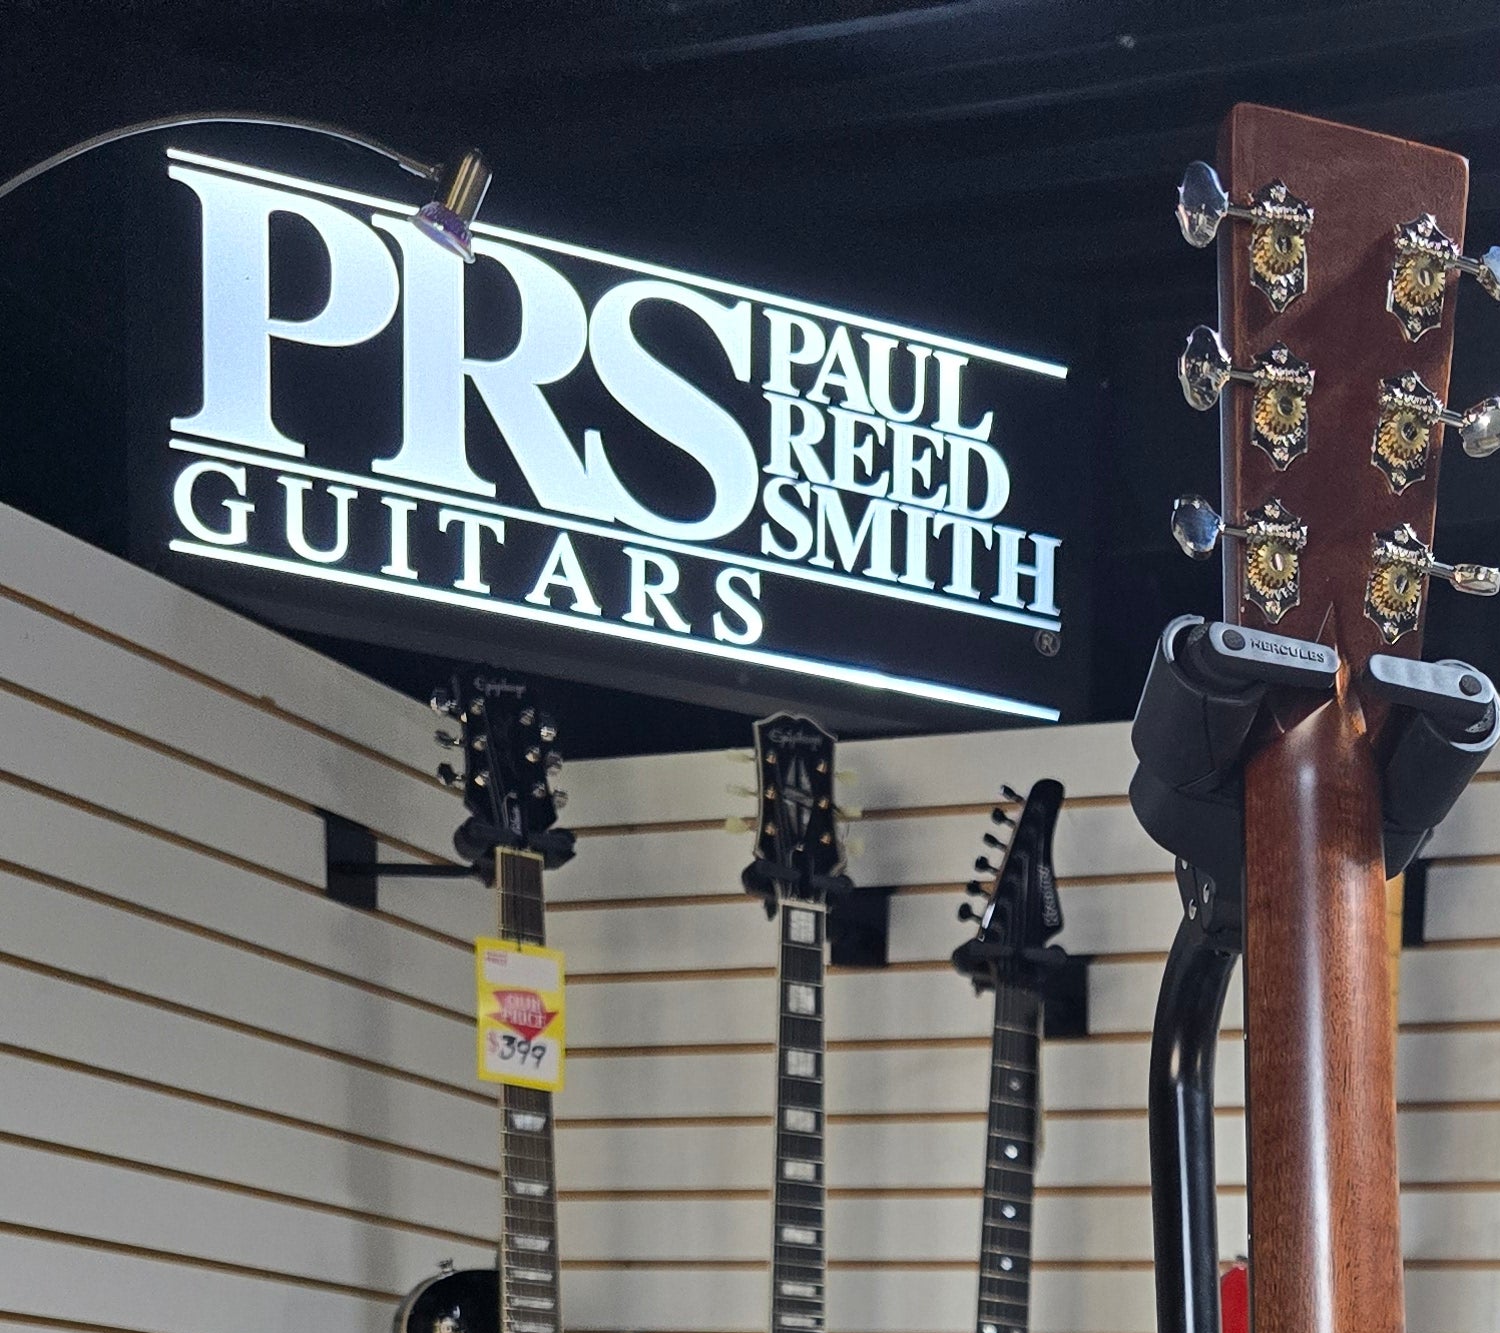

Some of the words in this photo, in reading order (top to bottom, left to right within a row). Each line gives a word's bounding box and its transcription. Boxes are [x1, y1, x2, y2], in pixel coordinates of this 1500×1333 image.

[169, 165, 760, 543] PRS
[762, 306, 993, 443] PAUL
[762, 391, 1011, 520] REED
[173, 462, 763, 646] GUITARS
[761, 475, 1062, 618] SMITH
[1251, 639, 1325, 663] HERCULES
